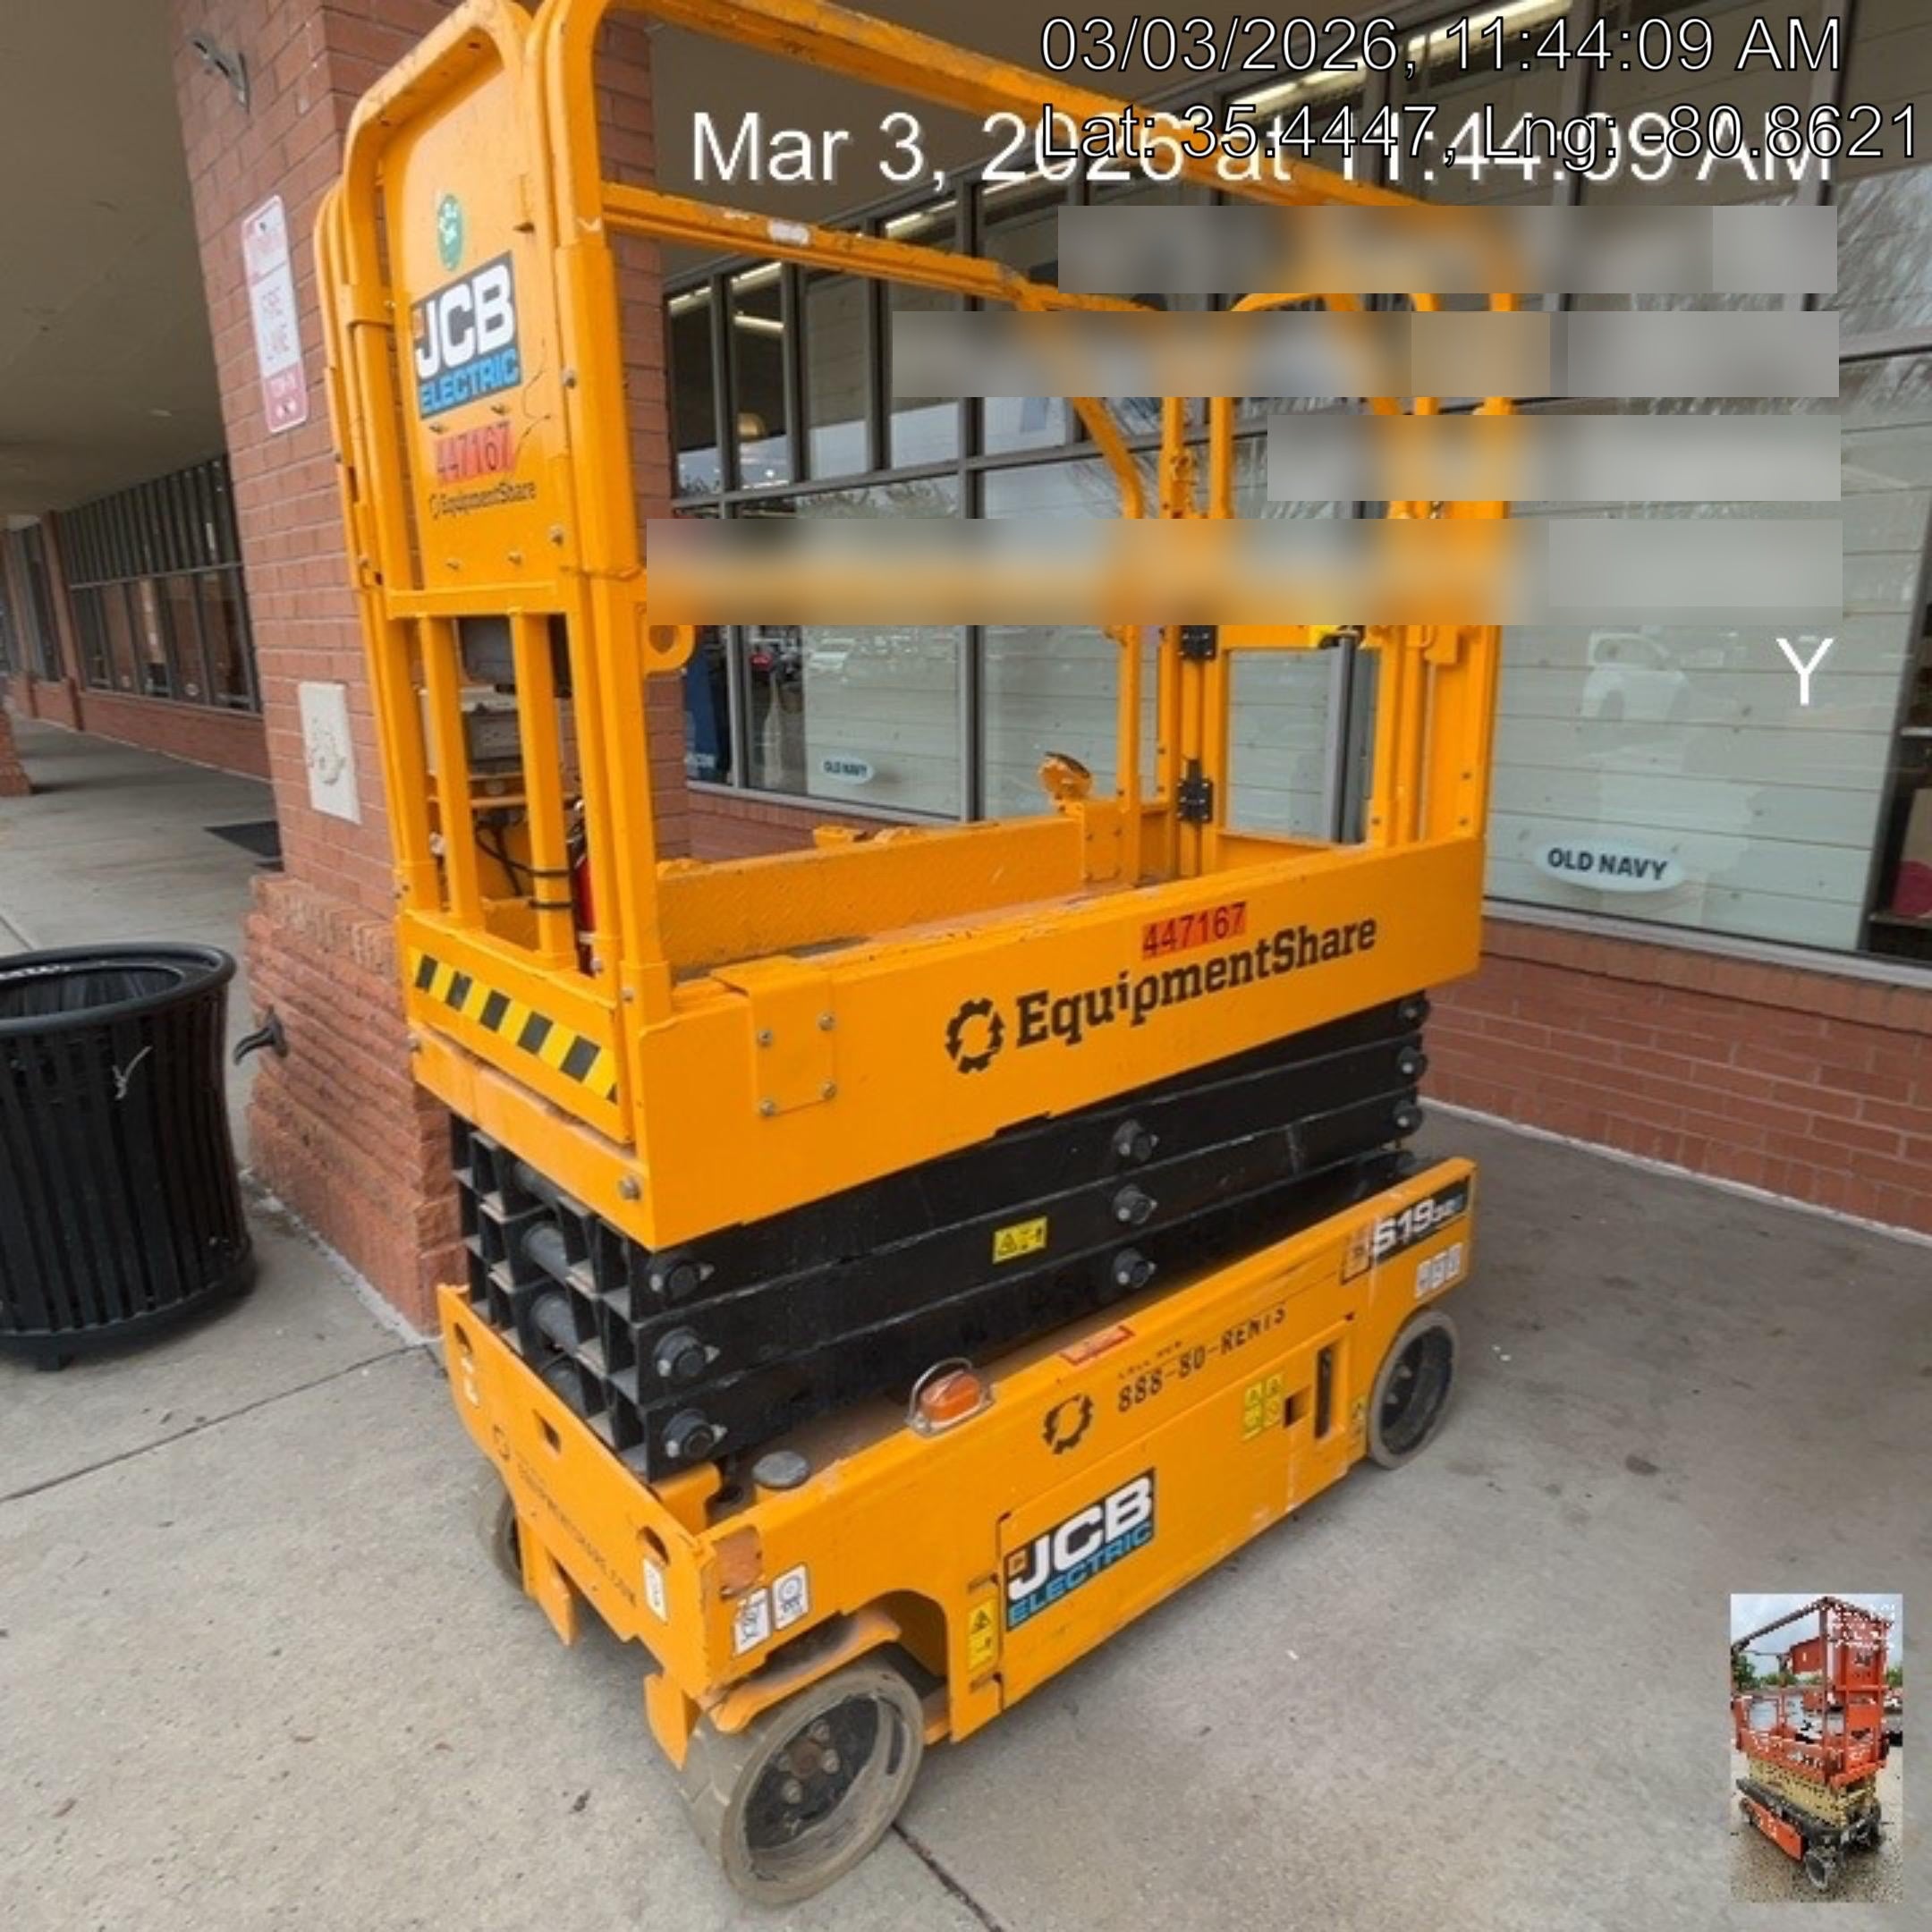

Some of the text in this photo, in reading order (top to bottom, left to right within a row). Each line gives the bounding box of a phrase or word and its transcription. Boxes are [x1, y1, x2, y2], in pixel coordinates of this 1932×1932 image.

[415, 264, 515, 379] JCB
[419, 352, 520, 410] ELECTRIC
[1547, 847, 1668, 882] OLD NAVY
[1016, 918, 1377, 1048] EquipmentShare
[1142, 902, 1246, 958] 447167
[1008, 1476, 1153, 1600] JCB
[1009, 1521, 1152, 1627] ELECTRIC
